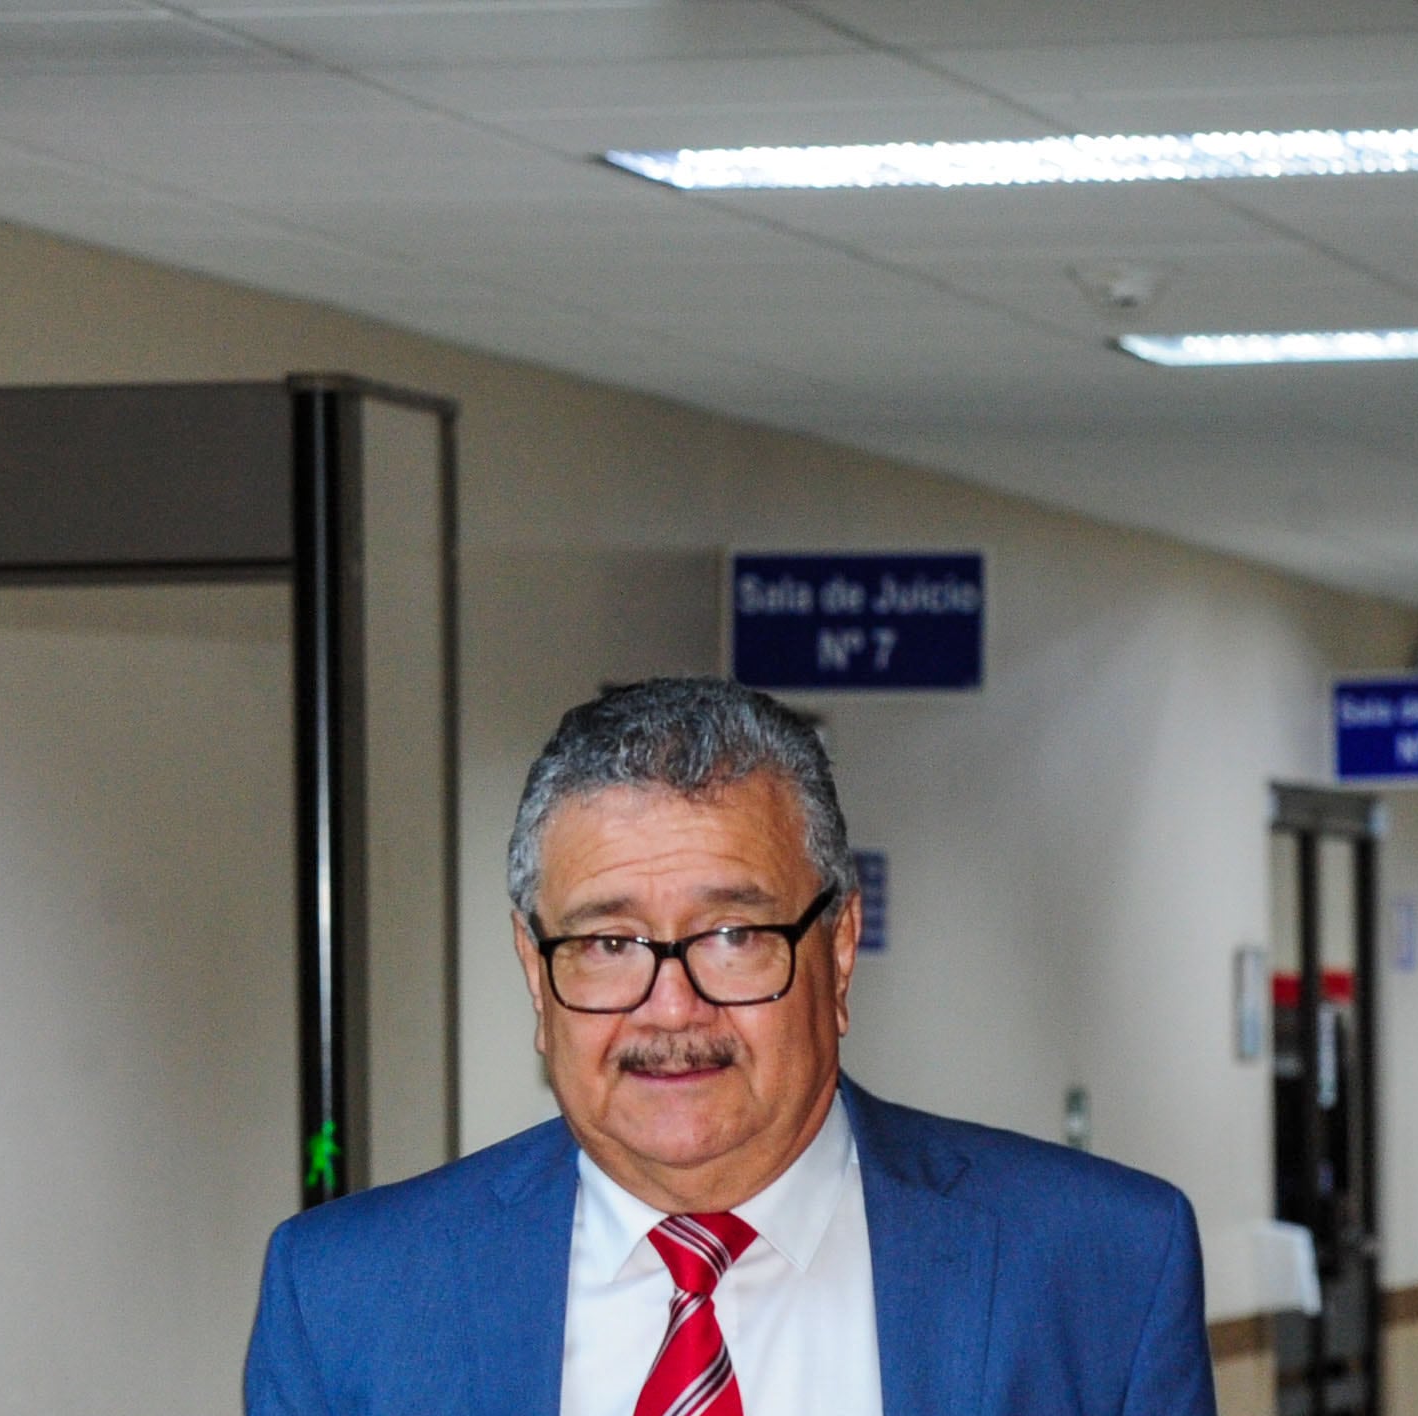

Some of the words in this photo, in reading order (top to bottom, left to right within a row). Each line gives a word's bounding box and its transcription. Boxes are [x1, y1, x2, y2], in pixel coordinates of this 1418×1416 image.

[738, 573, 813, 615] Sala
[820, 574, 865, 615] de
[872, 573, 980, 615] Juicio
[873, 629, 896, 670] 7
[1338, 697, 1393, 726] Sala
